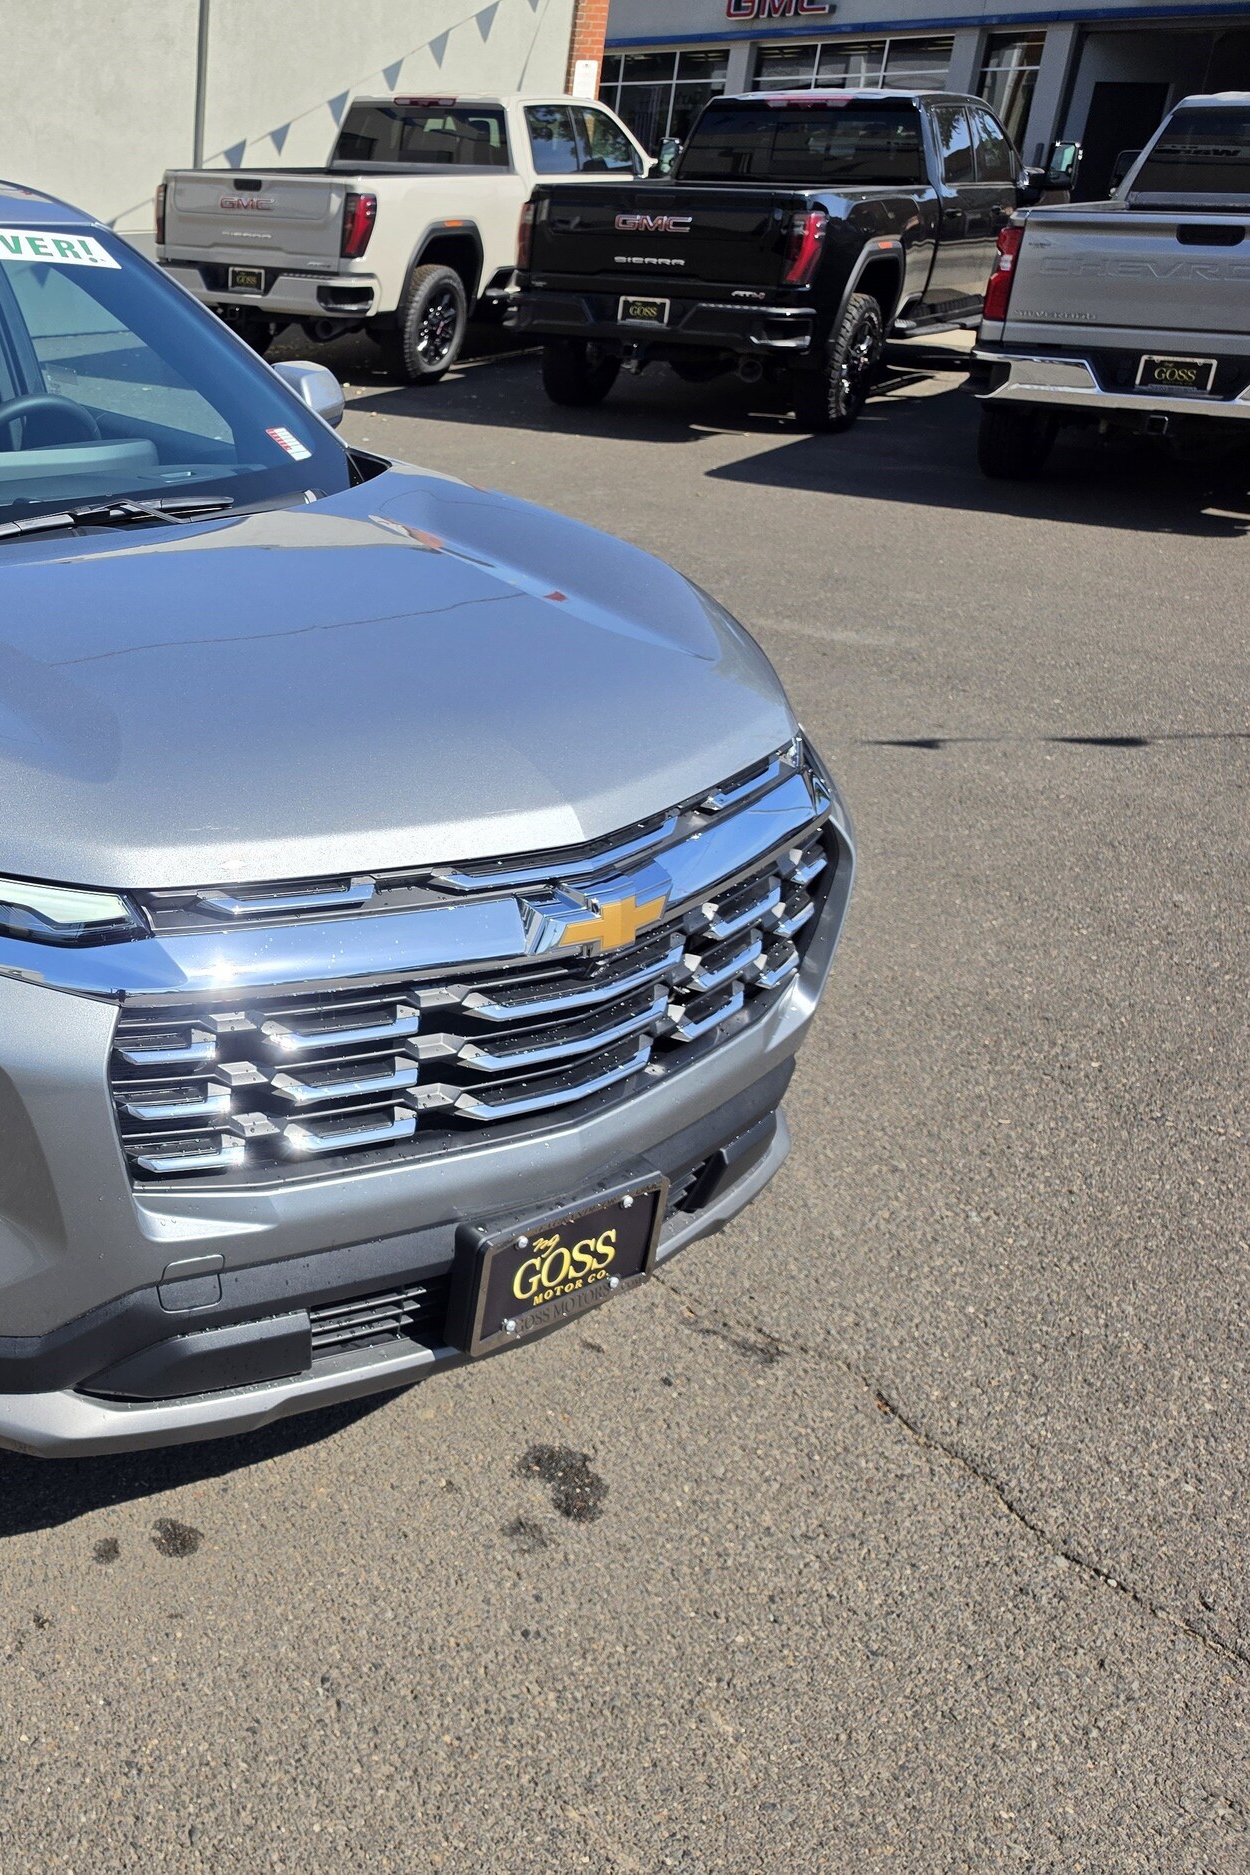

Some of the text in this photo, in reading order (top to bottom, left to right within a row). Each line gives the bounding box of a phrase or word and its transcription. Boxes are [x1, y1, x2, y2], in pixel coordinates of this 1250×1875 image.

[219, 196, 276, 211] GMC
[614, 214, 693, 233] GMC
[1154, 367, 1197, 382] GOSS
[513, 1228, 617, 1300] GOSS
[533, 1279, 584, 1306] MOTOR
